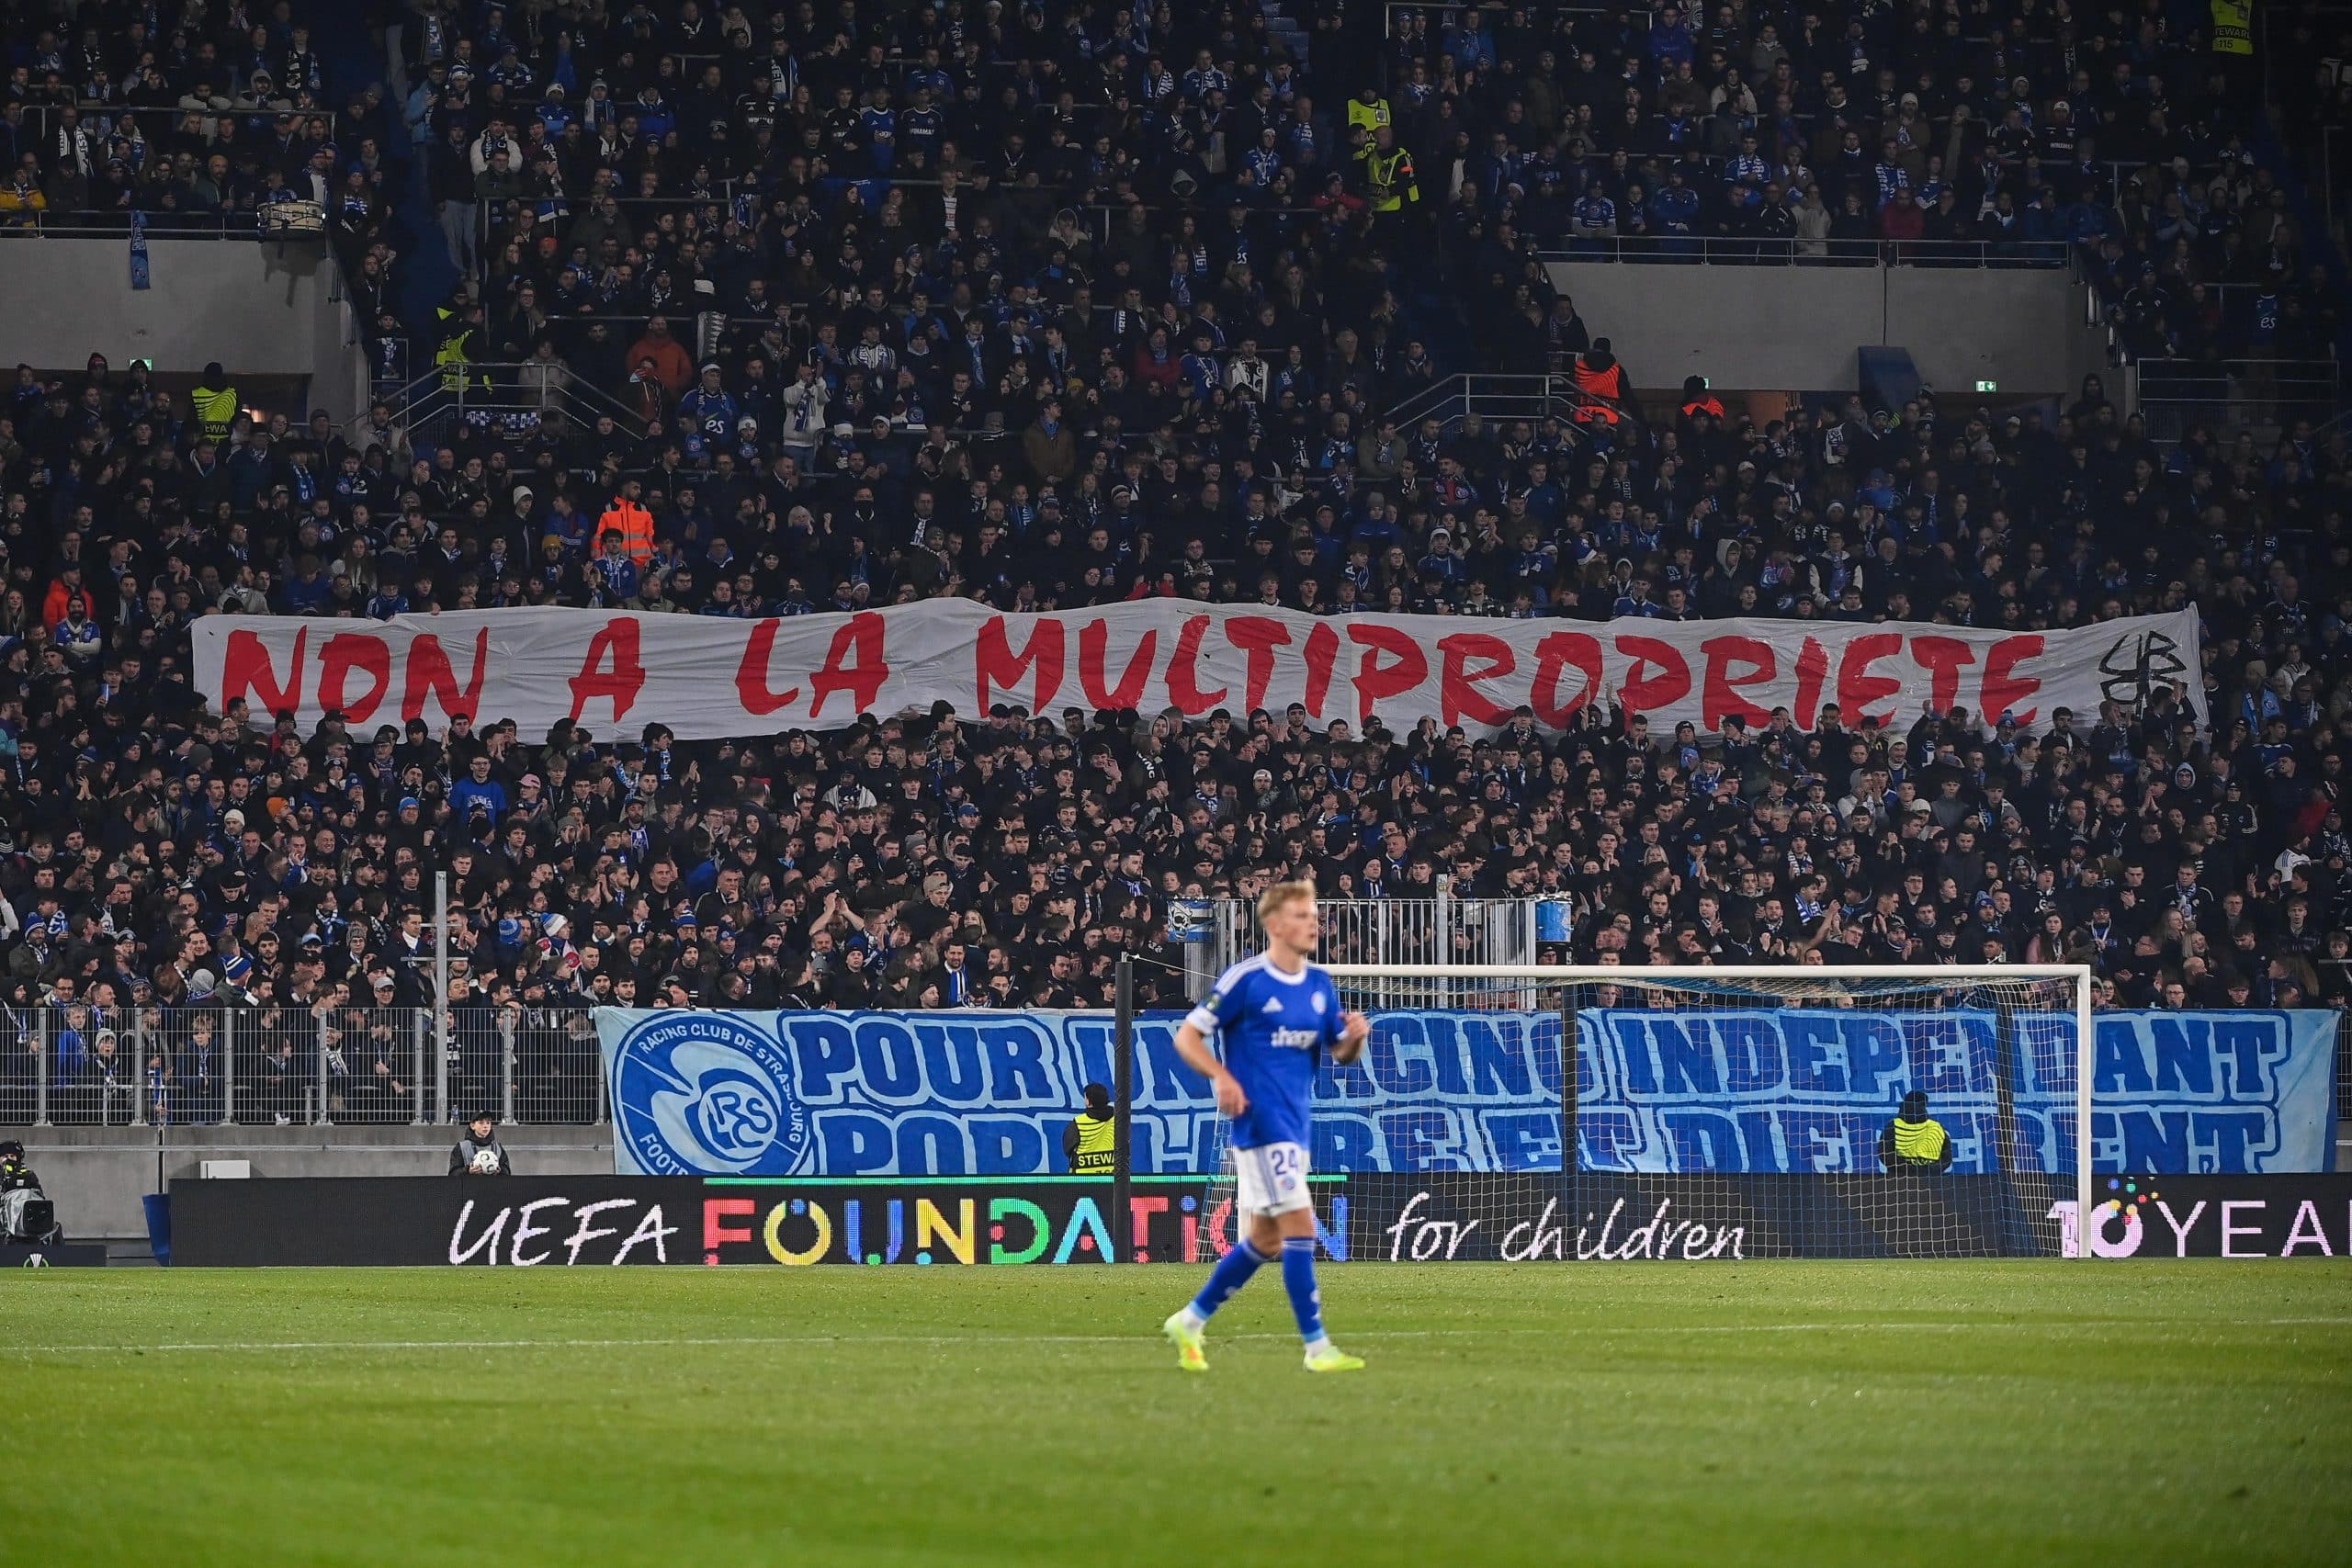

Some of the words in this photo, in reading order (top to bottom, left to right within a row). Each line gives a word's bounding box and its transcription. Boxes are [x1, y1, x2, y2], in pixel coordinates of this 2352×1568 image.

[2218, 39, 2233, 49] 115
[221, 625, 487, 727] NON
[568, 617, 646, 724] A
[735, 612, 888, 717] LA
[976, 615, 2044, 732] MULTIPROPRIETE
[638, 1024, 687, 1054] RACING
[691, 1023, 730, 1040] CLUB
[734, 1033, 753, 1052] DE
[756, 1048, 805, 1145] STRASOURG
[788, 1021, 1055, 1101] POUR
[1075, 1026, 1215, 1101] UN
[1312, 1017, 1597, 1098] ACING
[1613, 1016, 2278, 1095] INDEPENDANT
[1078, 1153, 1114, 1167] STEW
[1272, 1148, 1299, 1176] 24
[448, 1196, 680, 1266] UEFA
[1387, 1191, 1478, 1261] for
[1500, 1197, 1745, 1261] children
[2155, 1200, 2352, 1257] YEA
